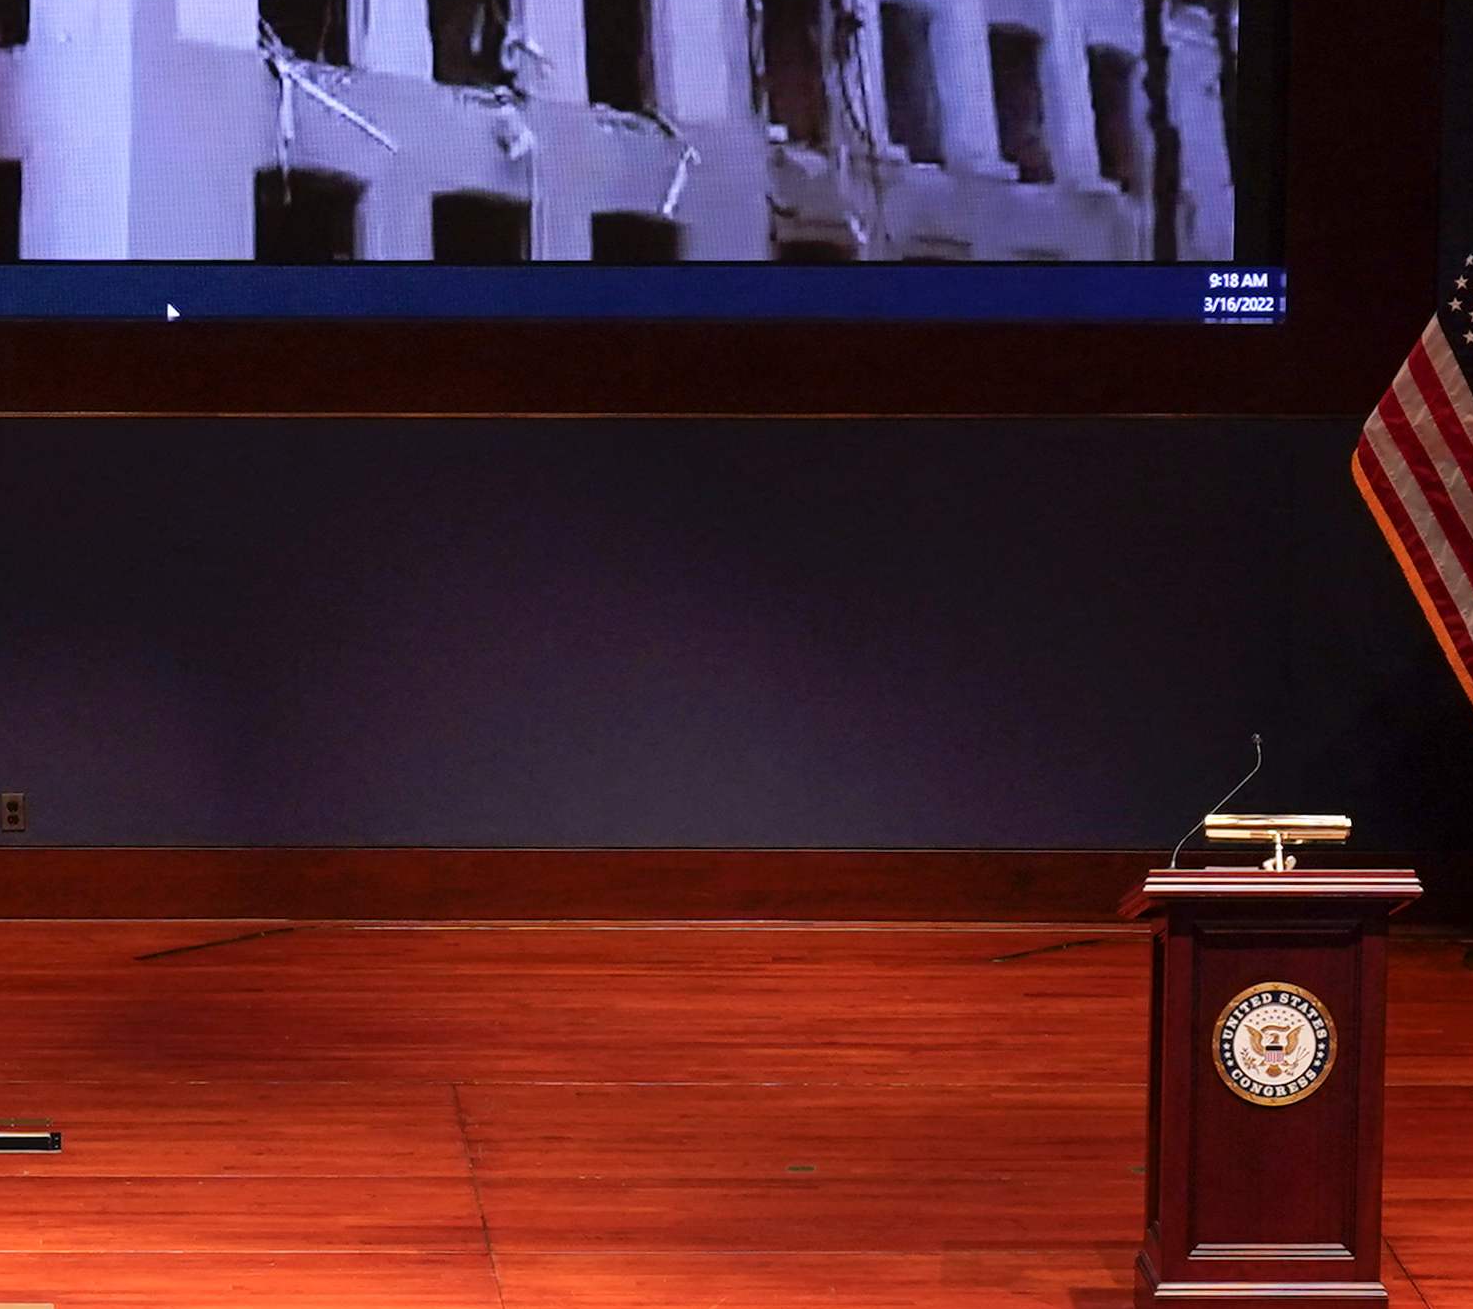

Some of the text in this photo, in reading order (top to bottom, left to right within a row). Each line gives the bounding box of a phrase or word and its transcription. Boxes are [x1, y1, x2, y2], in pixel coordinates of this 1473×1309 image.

[1209, 273, 1268, 288] 9:18 AM
[1204, 296, 1274, 313] 3/16/2022
[1223, 992, 1327, 1041] UNITED STATES
[1231, 1068, 1318, 1097] CONGRESS
